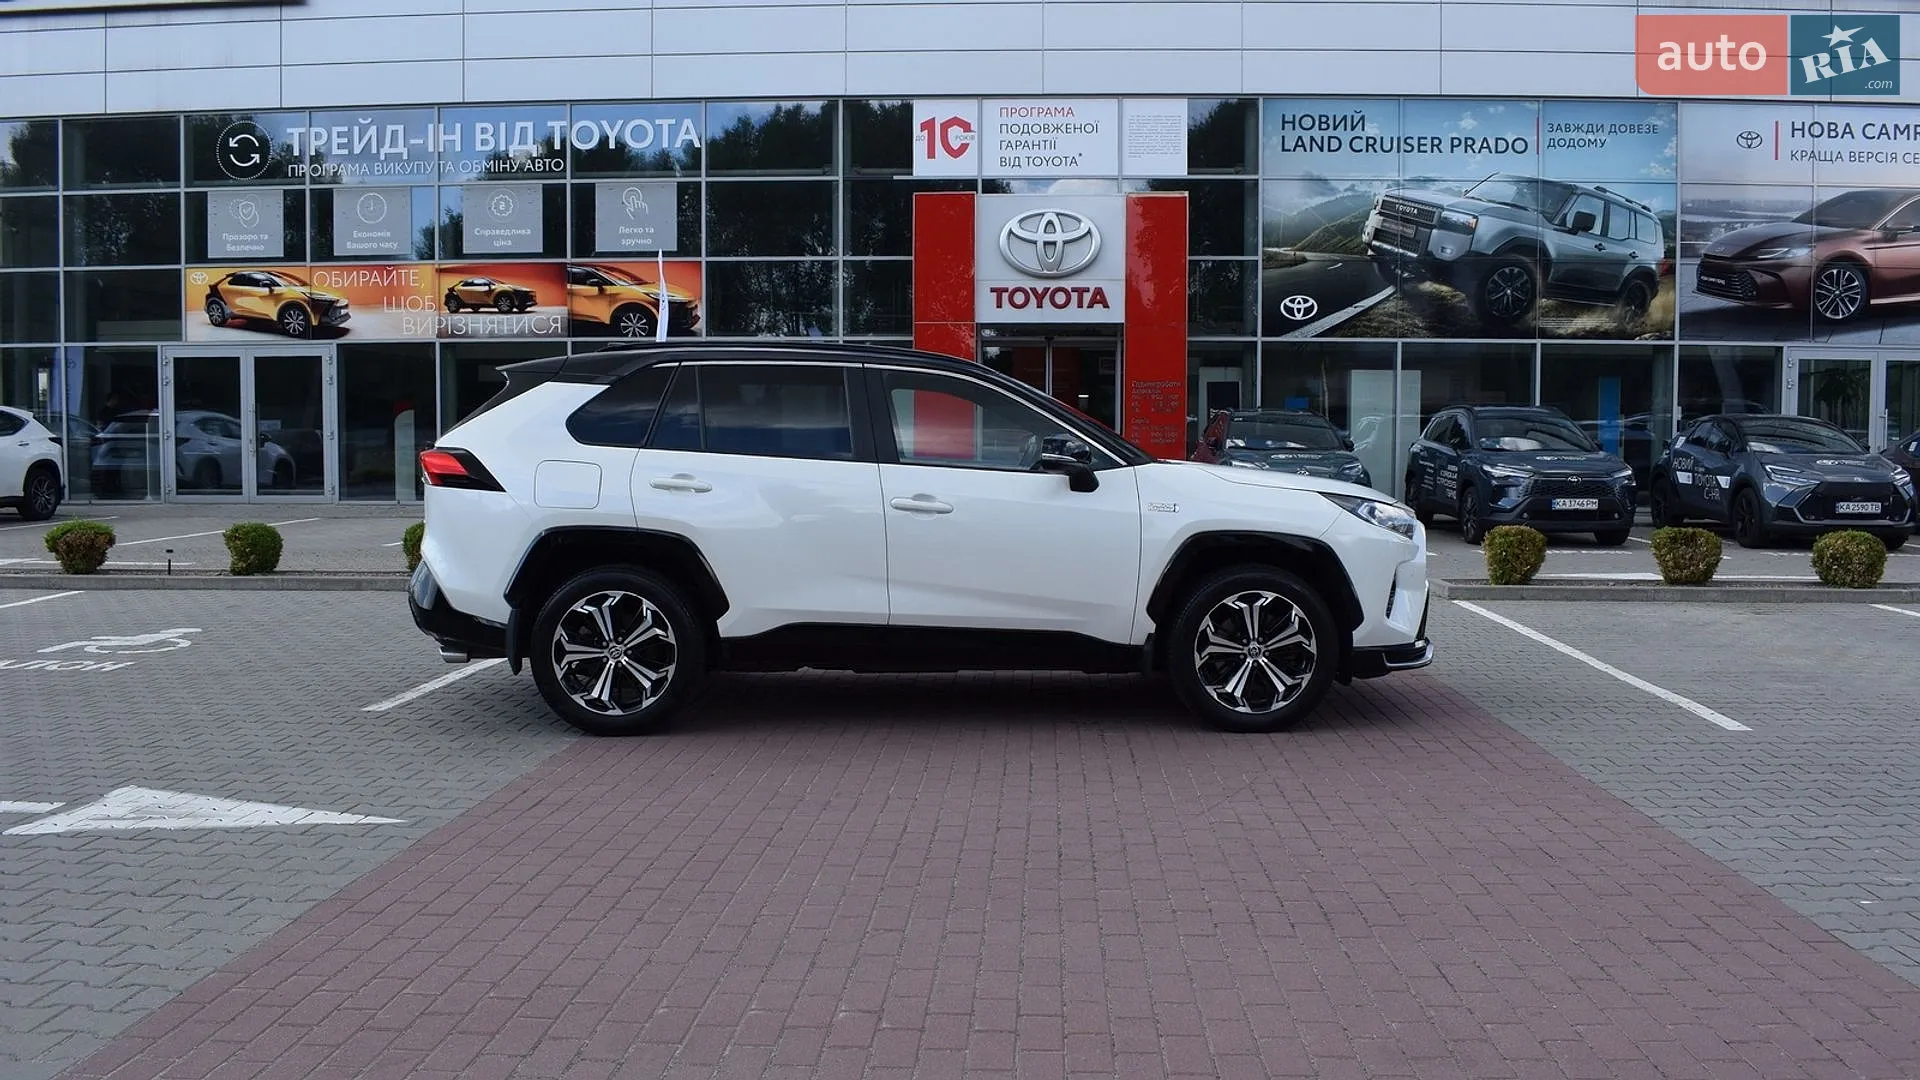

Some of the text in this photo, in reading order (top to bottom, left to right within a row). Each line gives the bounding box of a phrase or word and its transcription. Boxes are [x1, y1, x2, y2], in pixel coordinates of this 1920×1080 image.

[999, 107, 1075, 118] ПРОГРАМА
[999, 120, 1100, 136] ПОДОВЖЕНОЇ
[1281, 109, 1366, 132] НОВИЙ
[1547, 123, 1660, 135] ЗАВЖДИ ДОВЕЗЕ
[1791, 121, 1855, 139] НОВА
[286, 118, 701, 161] ТРЕЙД-ІН ВІД TOYOTA
[999, 137, 1057, 151] ГАРАНТІЇ
[1281, 135, 1529, 155] LAND CRUISER PRADO
[1547, 137, 1607, 150] ДОДОМУ
[999, 156, 1022, 169] ВІД
[1790, 149, 1844, 164] КРАЩА
[1849, 151, 1898, 164] ВЕРСІЯ
[288, 158, 565, 178] ПРОГРАМА ВИКУПУ ТА ОБМІНУ АВТО
[474, 227, 531, 237] Справедлива
[618, 226, 655, 235] Легко та
[493, 239, 512, 247] ціна
[621, 238, 652, 247] зручно
[313, 265, 425, 289] ОБИРАЙТЕ,
[990, 286, 1110, 310] TOYOTA
[402, 315, 562, 336] ВИРІЗНЯТИСЯ
